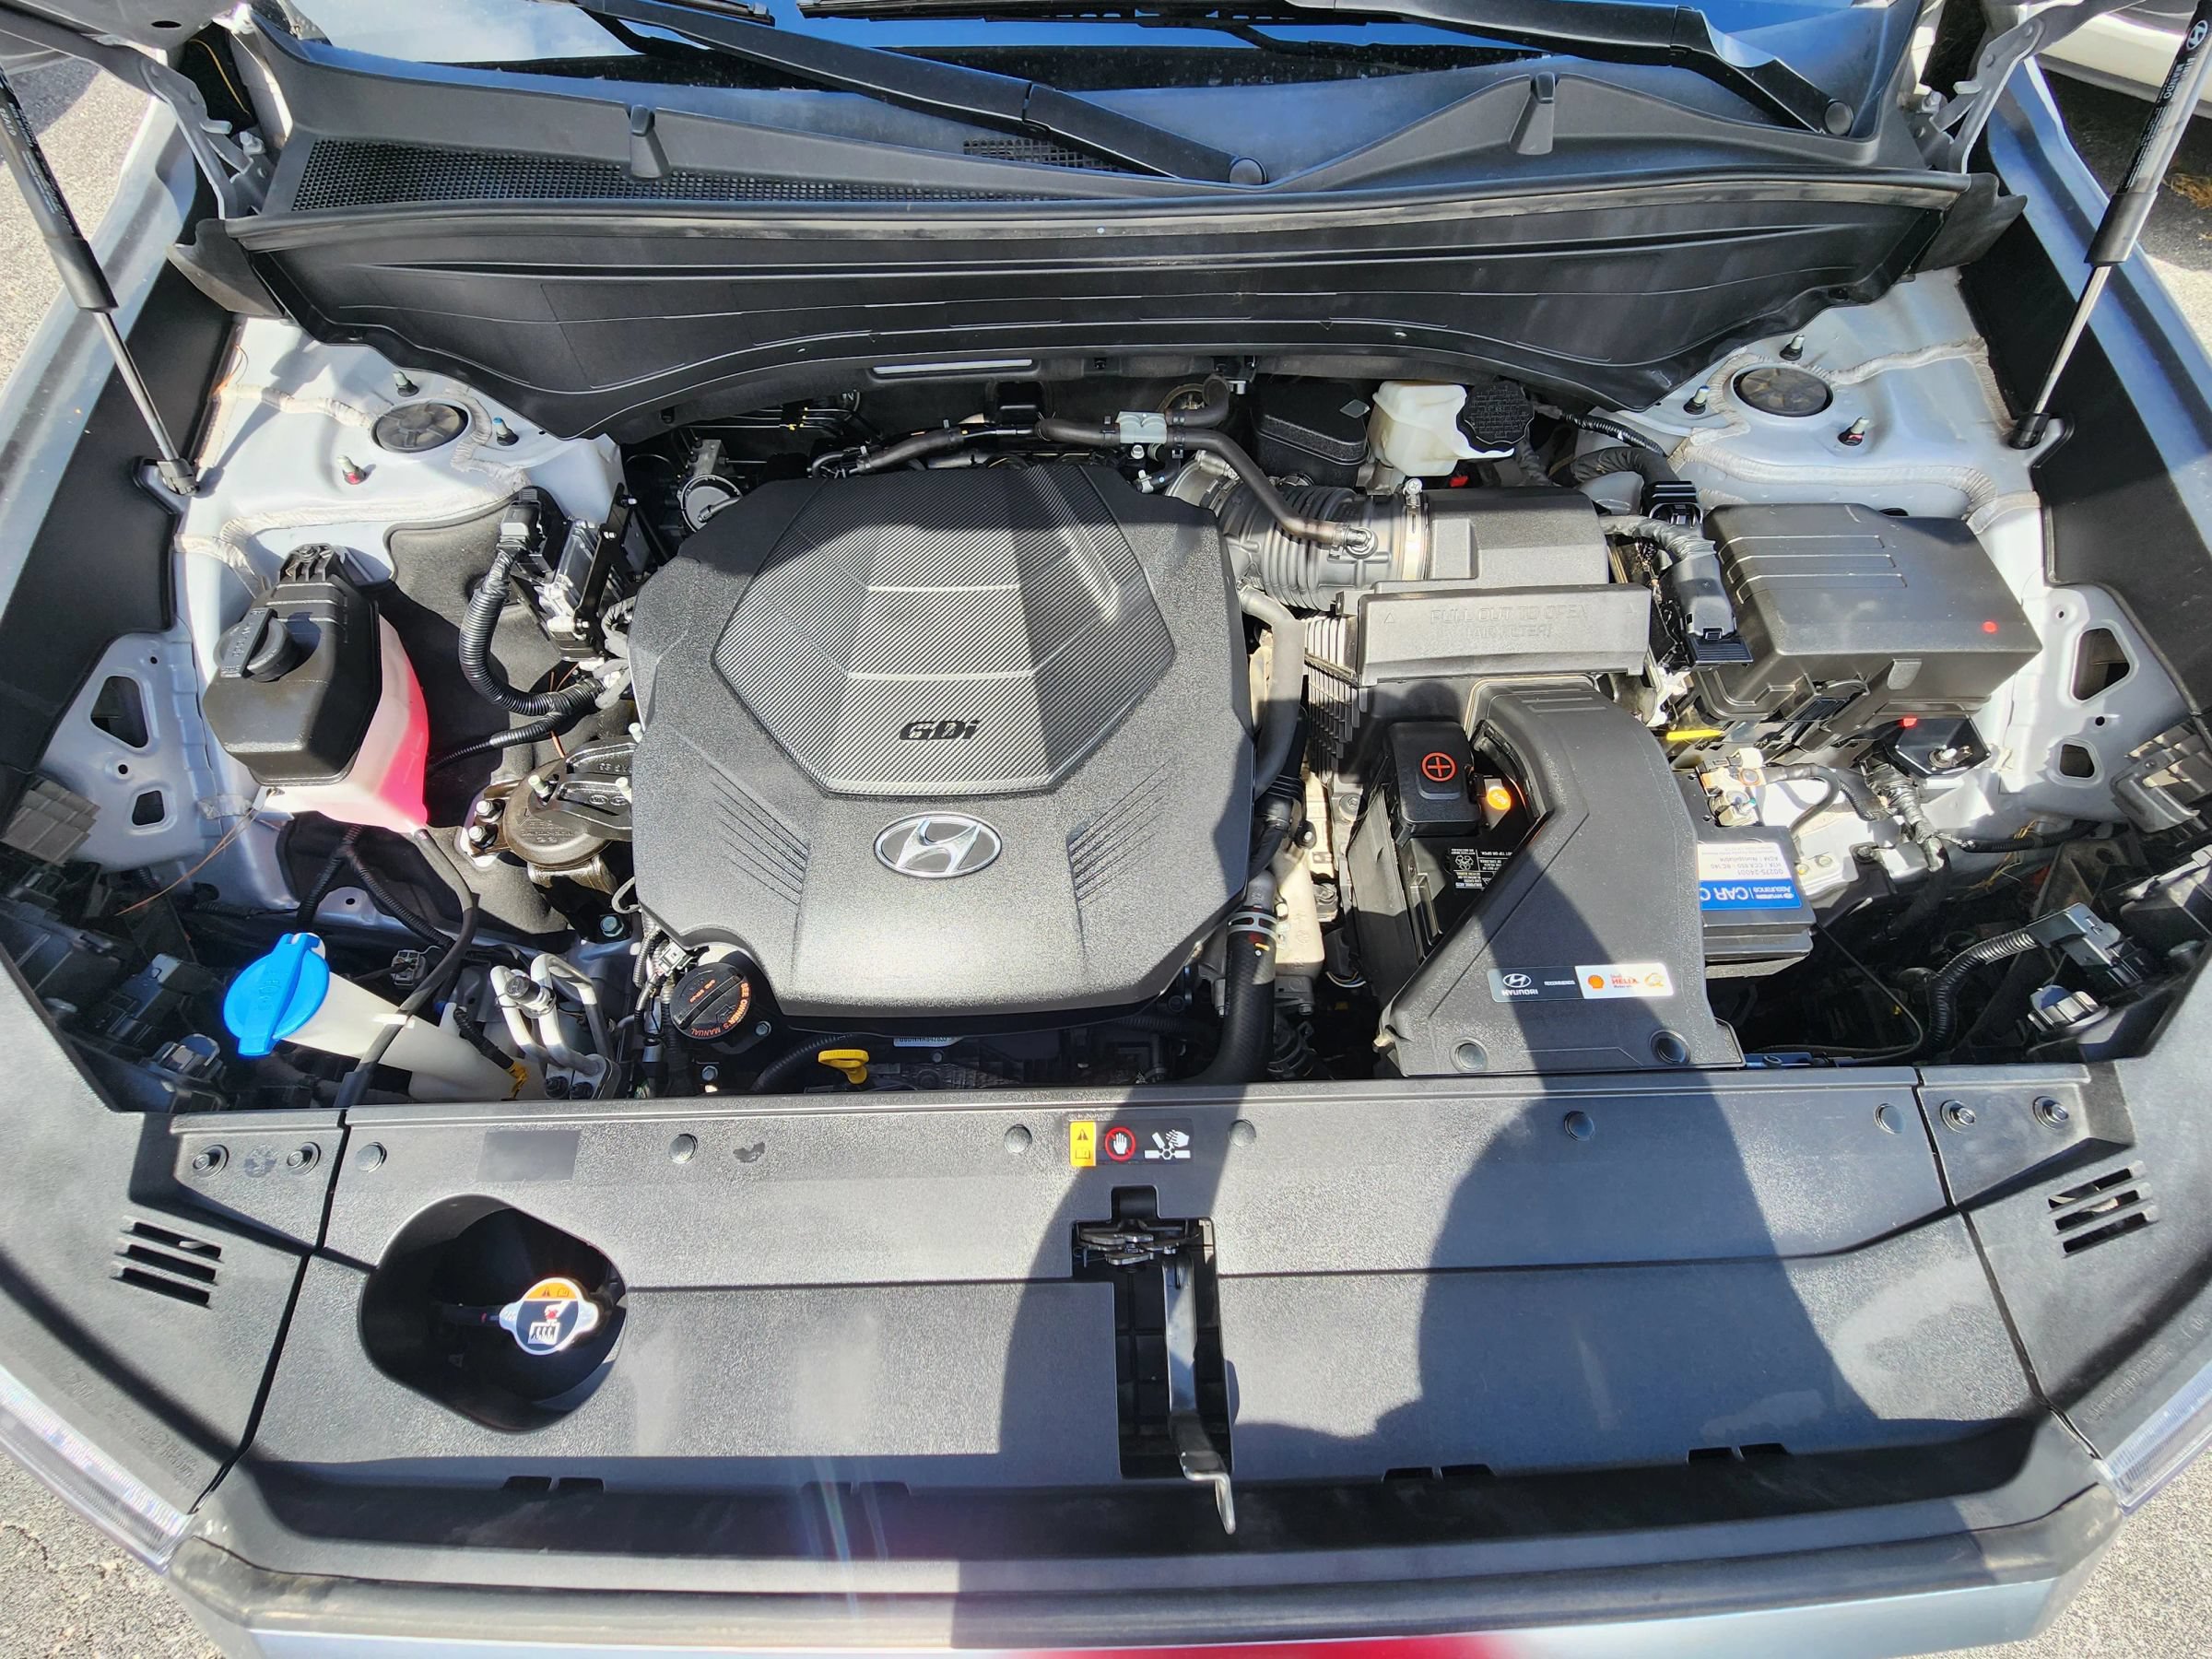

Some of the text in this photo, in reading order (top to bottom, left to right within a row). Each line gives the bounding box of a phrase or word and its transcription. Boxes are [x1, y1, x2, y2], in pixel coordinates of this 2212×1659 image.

[1430, 603, 1590, 625] PULL OUT TO OPEN
[899, 720, 980, 740] GDi
[1712, 887, 1748, 900] CAR
[1500, 988, 1538, 996] HYUNDAI
[691, 982, 749, 1036] SEE OWNER'S MANUAL
